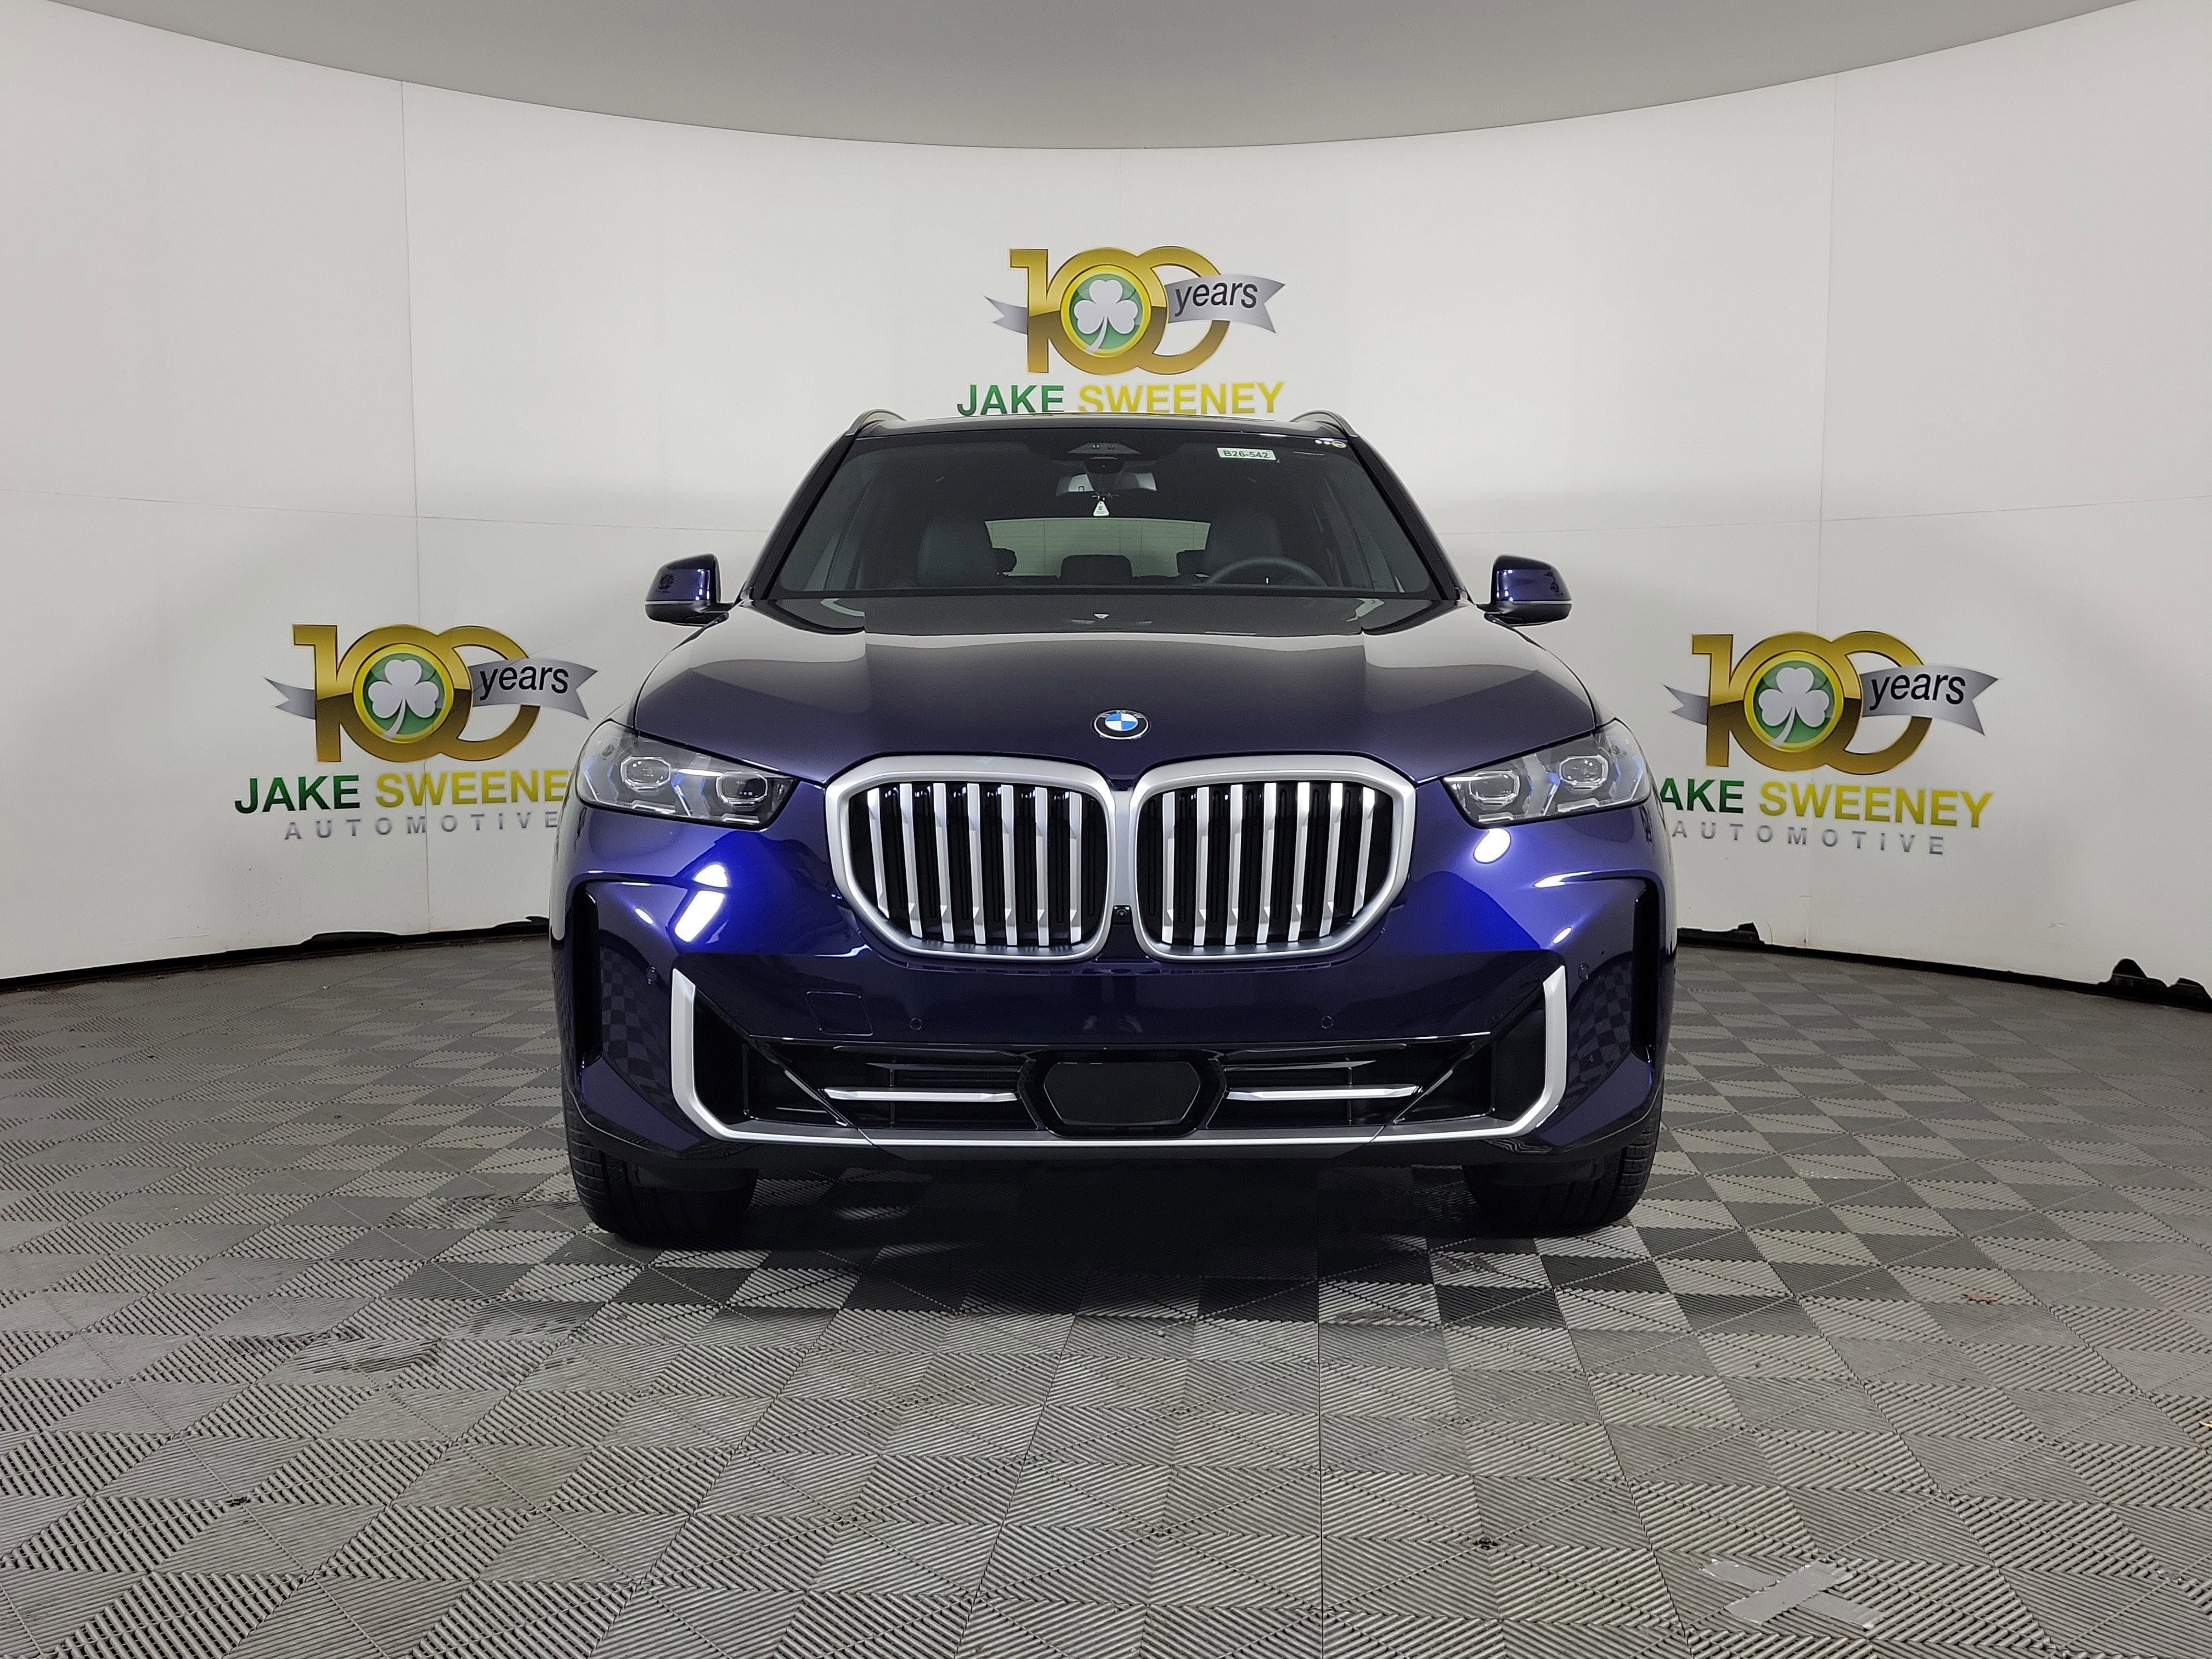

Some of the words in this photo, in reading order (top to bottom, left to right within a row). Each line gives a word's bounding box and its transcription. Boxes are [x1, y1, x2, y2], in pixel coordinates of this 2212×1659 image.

[1008, 246, 1230, 375] 100
[1174, 280, 1258, 317] years
[957, 384, 1064, 416] JAKE
[1078, 381, 1284, 415] SWEENEY
[1223, 450, 1270, 459] B26-542
[292, 623, 540, 763] 100
[479, 665, 569, 701] years
[1869, 673, 1966, 710] years
[1691, 630, 1932, 775] 100
[234, 774, 360, 814] JAKE
[375, 770, 568, 809] SWEENE
[1660, 777, 1745, 814] AKE
[1759, 781, 1994, 828] SWEENEY
[284, 811, 557, 840] AUTOMOTIVE
[1672, 820, 1944, 855] AUTOMOTIVE
